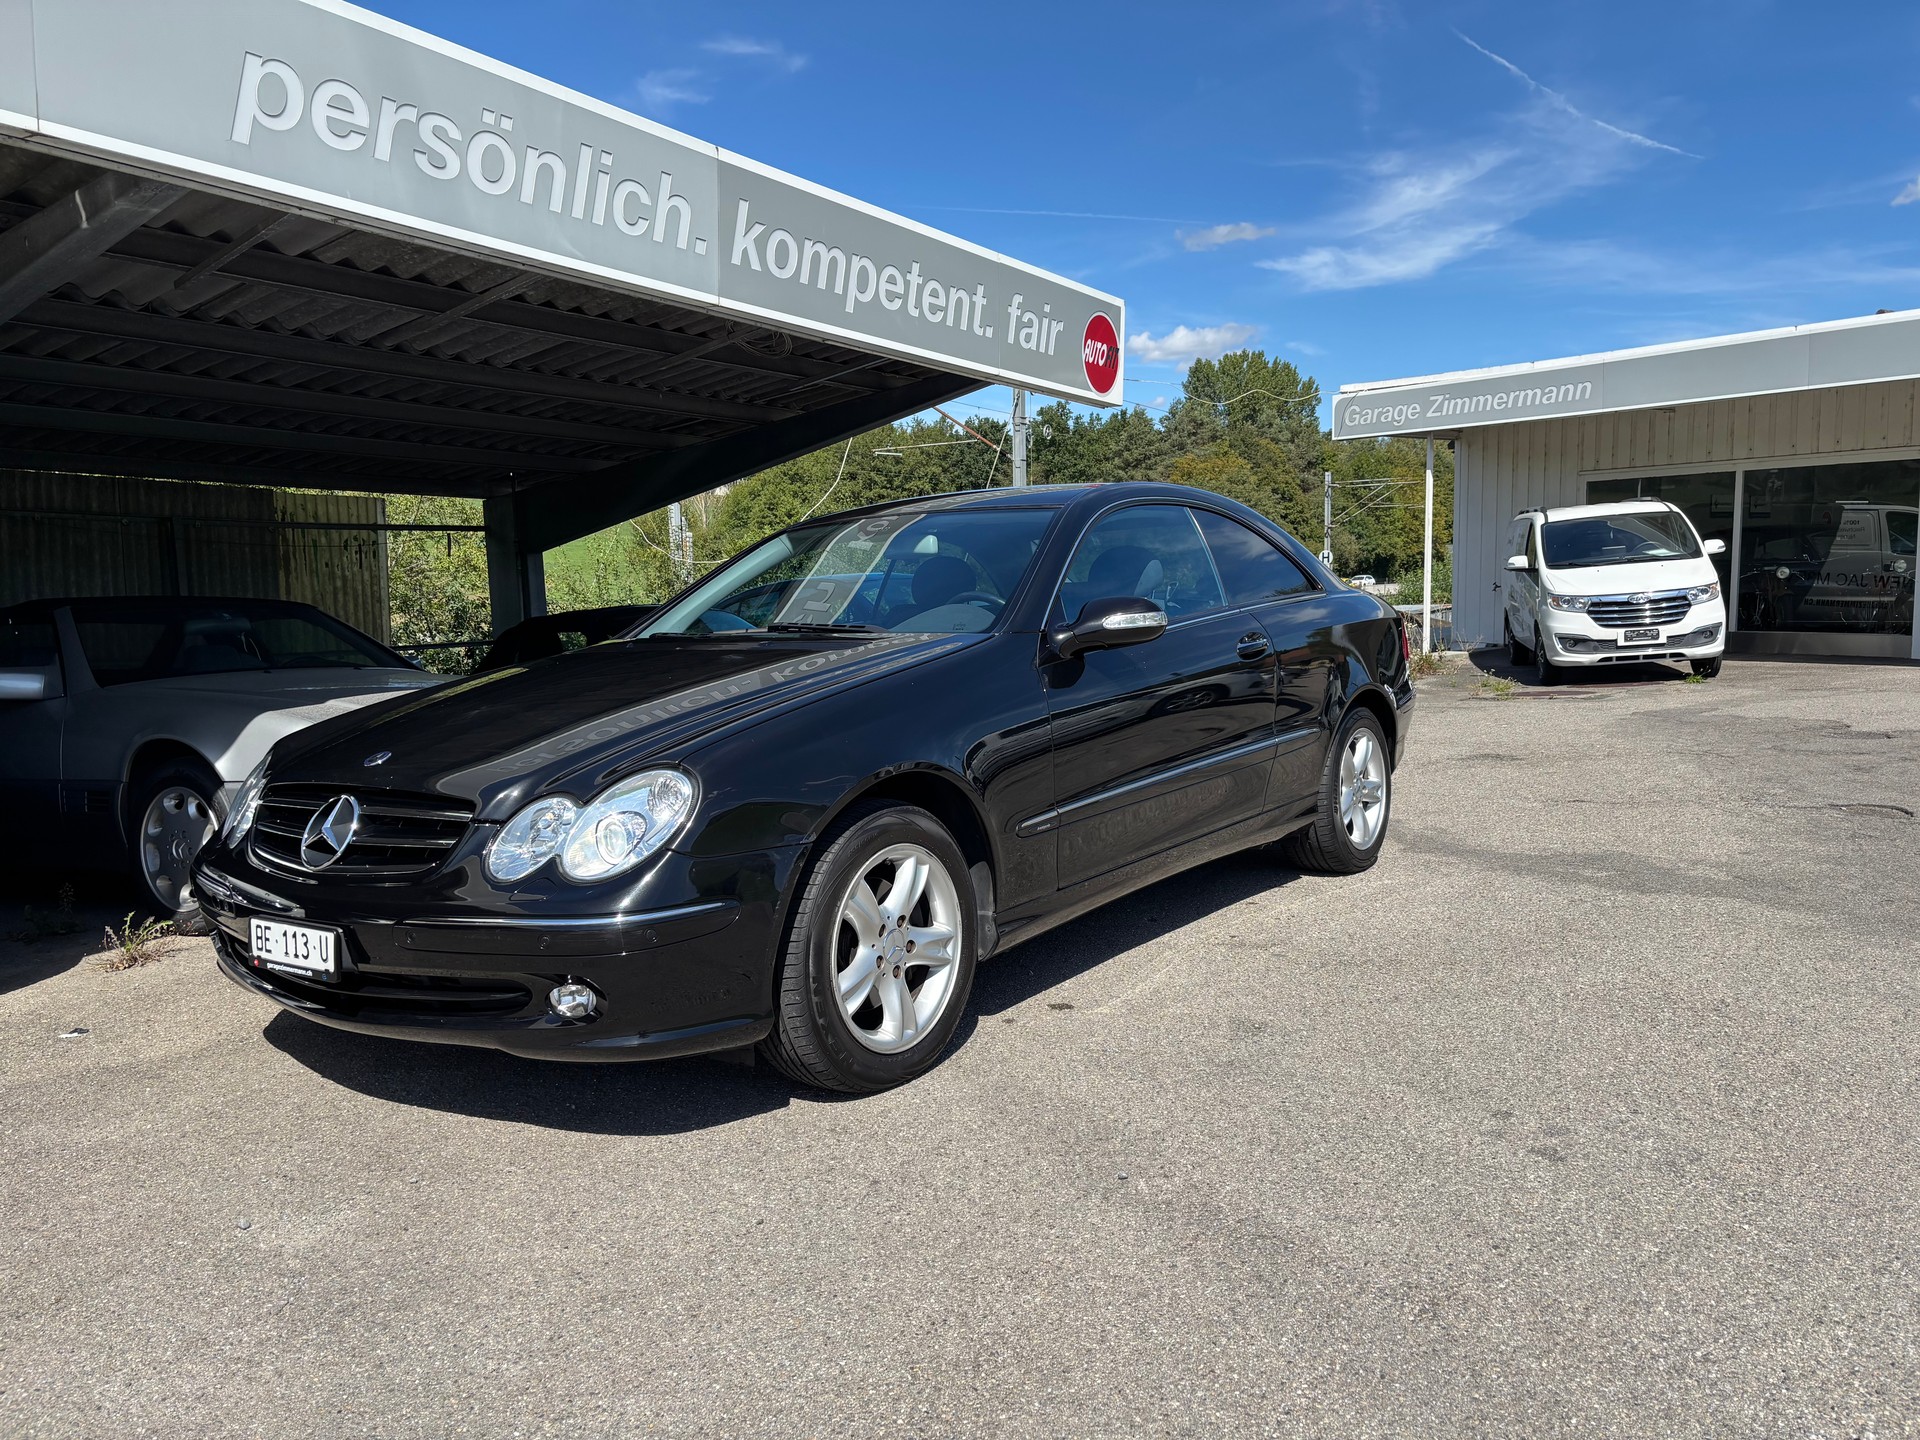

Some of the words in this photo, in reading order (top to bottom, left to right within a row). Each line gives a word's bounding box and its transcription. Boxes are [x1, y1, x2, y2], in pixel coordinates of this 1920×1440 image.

[229, 50, 708, 257] persönlich.
[730, 197, 993, 339] kompetent.
[1007, 292, 1063, 356] fair
[1084, 338, 1119, 369] AUTOFIT
[1344, 402, 1421, 426] Garage
[1426, 380, 1592, 418] Zimmermann
